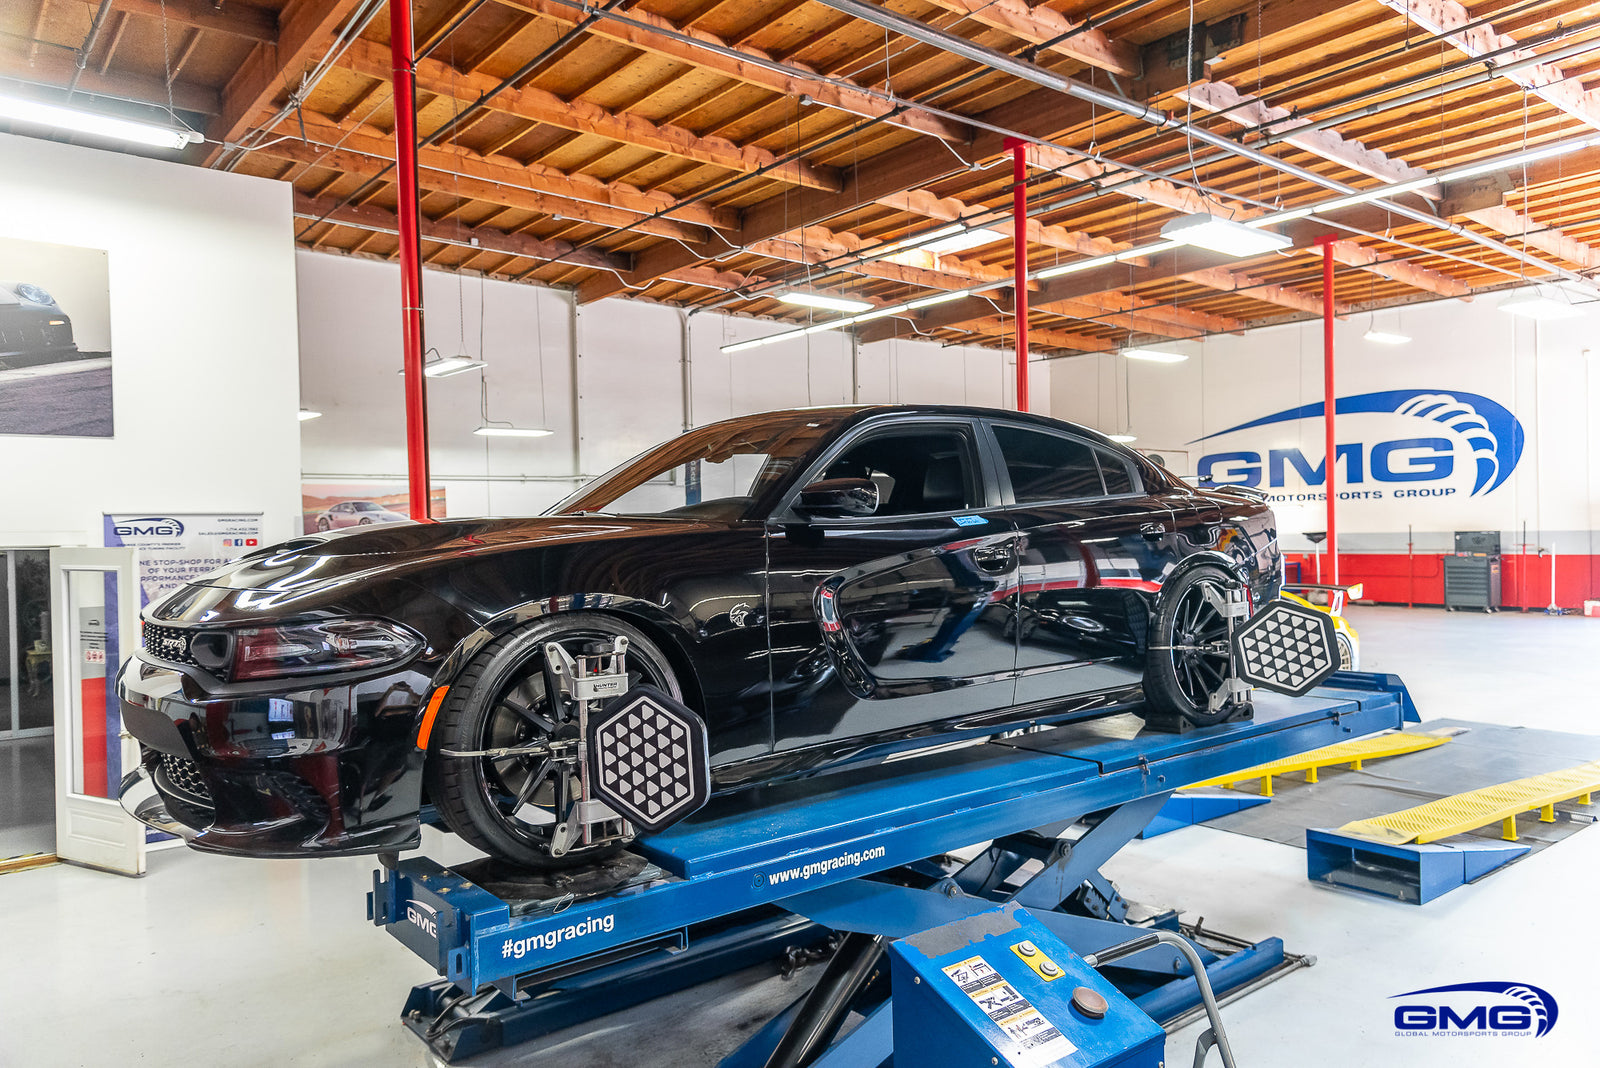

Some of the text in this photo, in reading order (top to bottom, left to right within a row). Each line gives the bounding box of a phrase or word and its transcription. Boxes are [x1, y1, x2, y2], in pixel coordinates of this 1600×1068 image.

[1197, 437, 1454, 488] GMG
[1267, 487, 1456, 502] MOTORSORTS GROUP
[113, 526, 173, 536] GMG
[768, 845, 886, 886] www.gmgracing.com
[501, 914, 615, 959] #gmgracing
